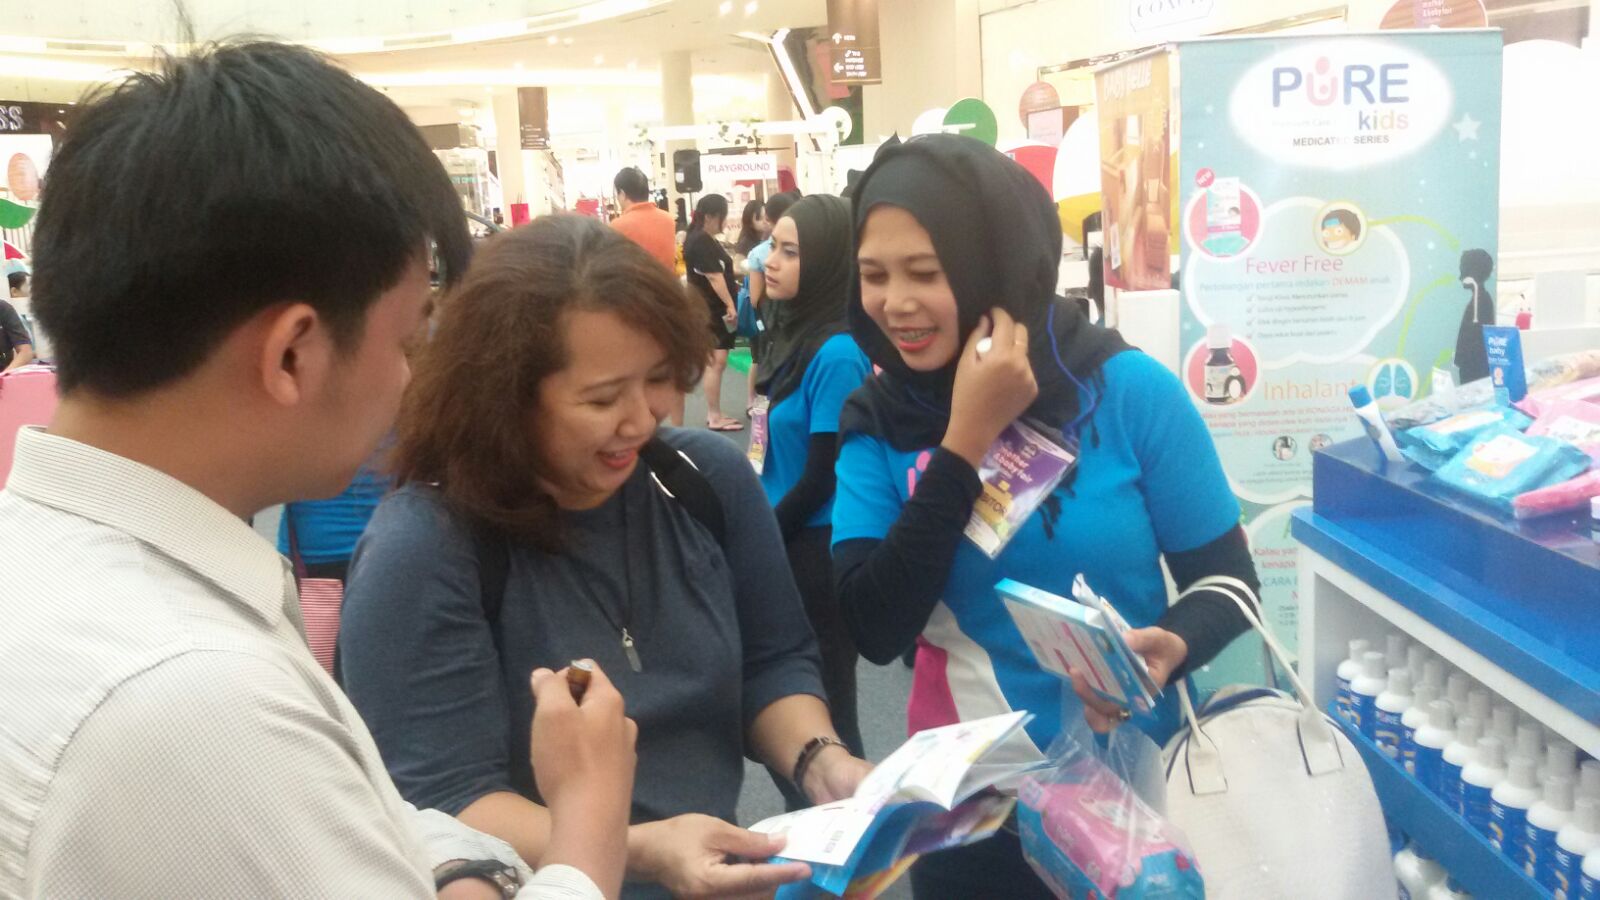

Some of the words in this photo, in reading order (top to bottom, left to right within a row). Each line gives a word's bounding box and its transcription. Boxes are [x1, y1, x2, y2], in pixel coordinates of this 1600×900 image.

[1272, 58, 1409, 107] PURE
[1358, 110, 1409, 131] kids
[1353, 135, 1390, 145] SERIES
[708, 163, 770, 173] PLAYGROUND
[1246, 256, 1298, 275] Fever
[1303, 255, 1344, 273] Free
[1332, 277, 1368, 287] DEMAM
[1489, 347, 1506, 357] baby
[1263, 576, 1292, 587] CARA
